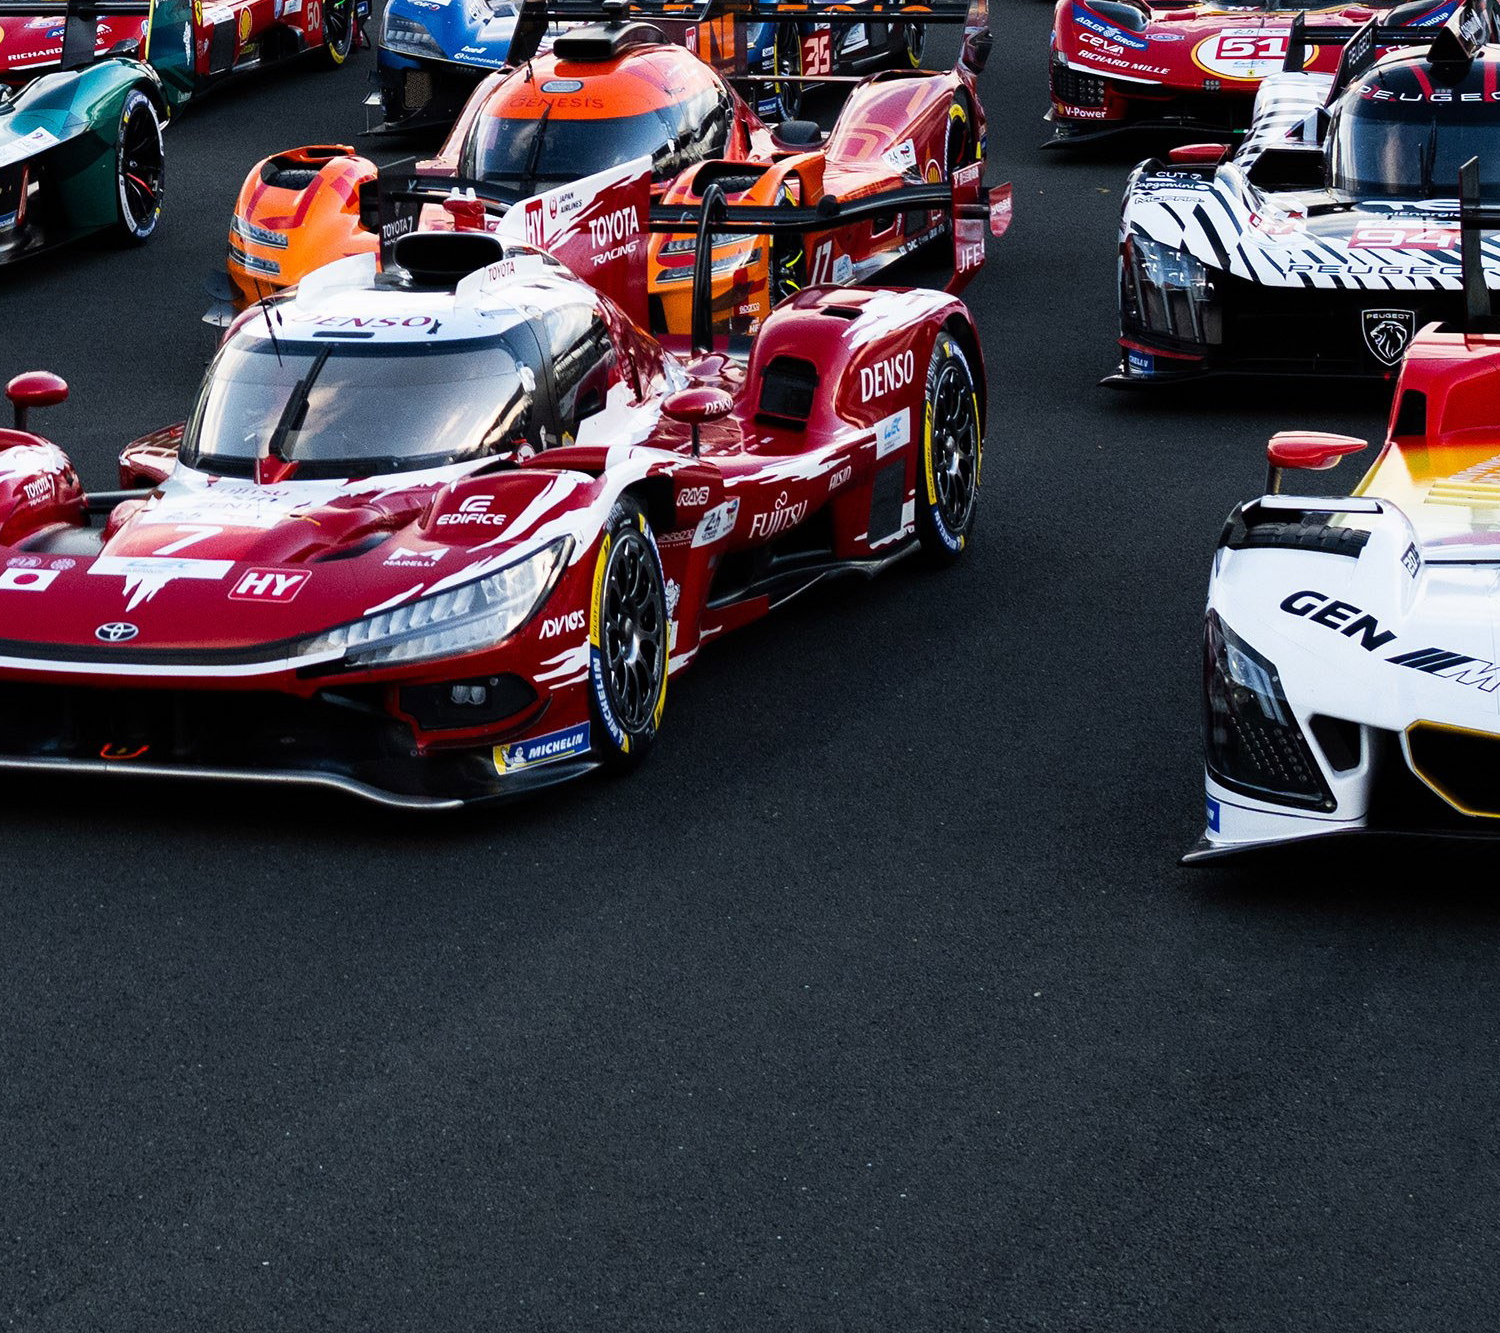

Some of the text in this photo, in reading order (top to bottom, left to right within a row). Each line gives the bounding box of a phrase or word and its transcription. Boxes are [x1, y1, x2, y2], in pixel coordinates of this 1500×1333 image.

[307, 1, 320, 32] 50
[1075, 15, 1105, 33] ADLER
[1120, 34, 1145, 49] GROUP
[804, 34, 830, 76] 35
[1219, 35, 1289, 58] 51
[1078, 49, 1170, 75] RICHARD MILLE
[509, 95, 604, 110] GENESIS
[1064, 105, 1107, 119] V-Power
[559, 192, 575, 204] JAPAN
[561, 199, 583, 213] AIRLINES
[589, 205, 639, 249] TOYOTA
[1354, 230, 1452, 248] 94
[591, 240, 640, 266] RACING
[811, 240, 832, 285] 17
[959, 244, 981, 273] JFE
[488, 261, 515, 281] TOYOTA
[1287, 264, 1496, 275] PEUGEOT
[859, 350, 914, 403] DENSO
[705, 398, 734, 415] DENSO
[677, 486, 709, 506] RAYS
[437, 513, 506, 526] EDIFICE
[749, 499, 808, 539] FUJITSU
[164, 525, 223, 555] 7
[383, 558, 436, 567] MARELLI
[240, 574, 303, 596] HY
[1280, 589, 1397, 652] GEN
[593, 656, 627, 744] MICHELIN
[528, 733, 584, 760] MICHELIN
